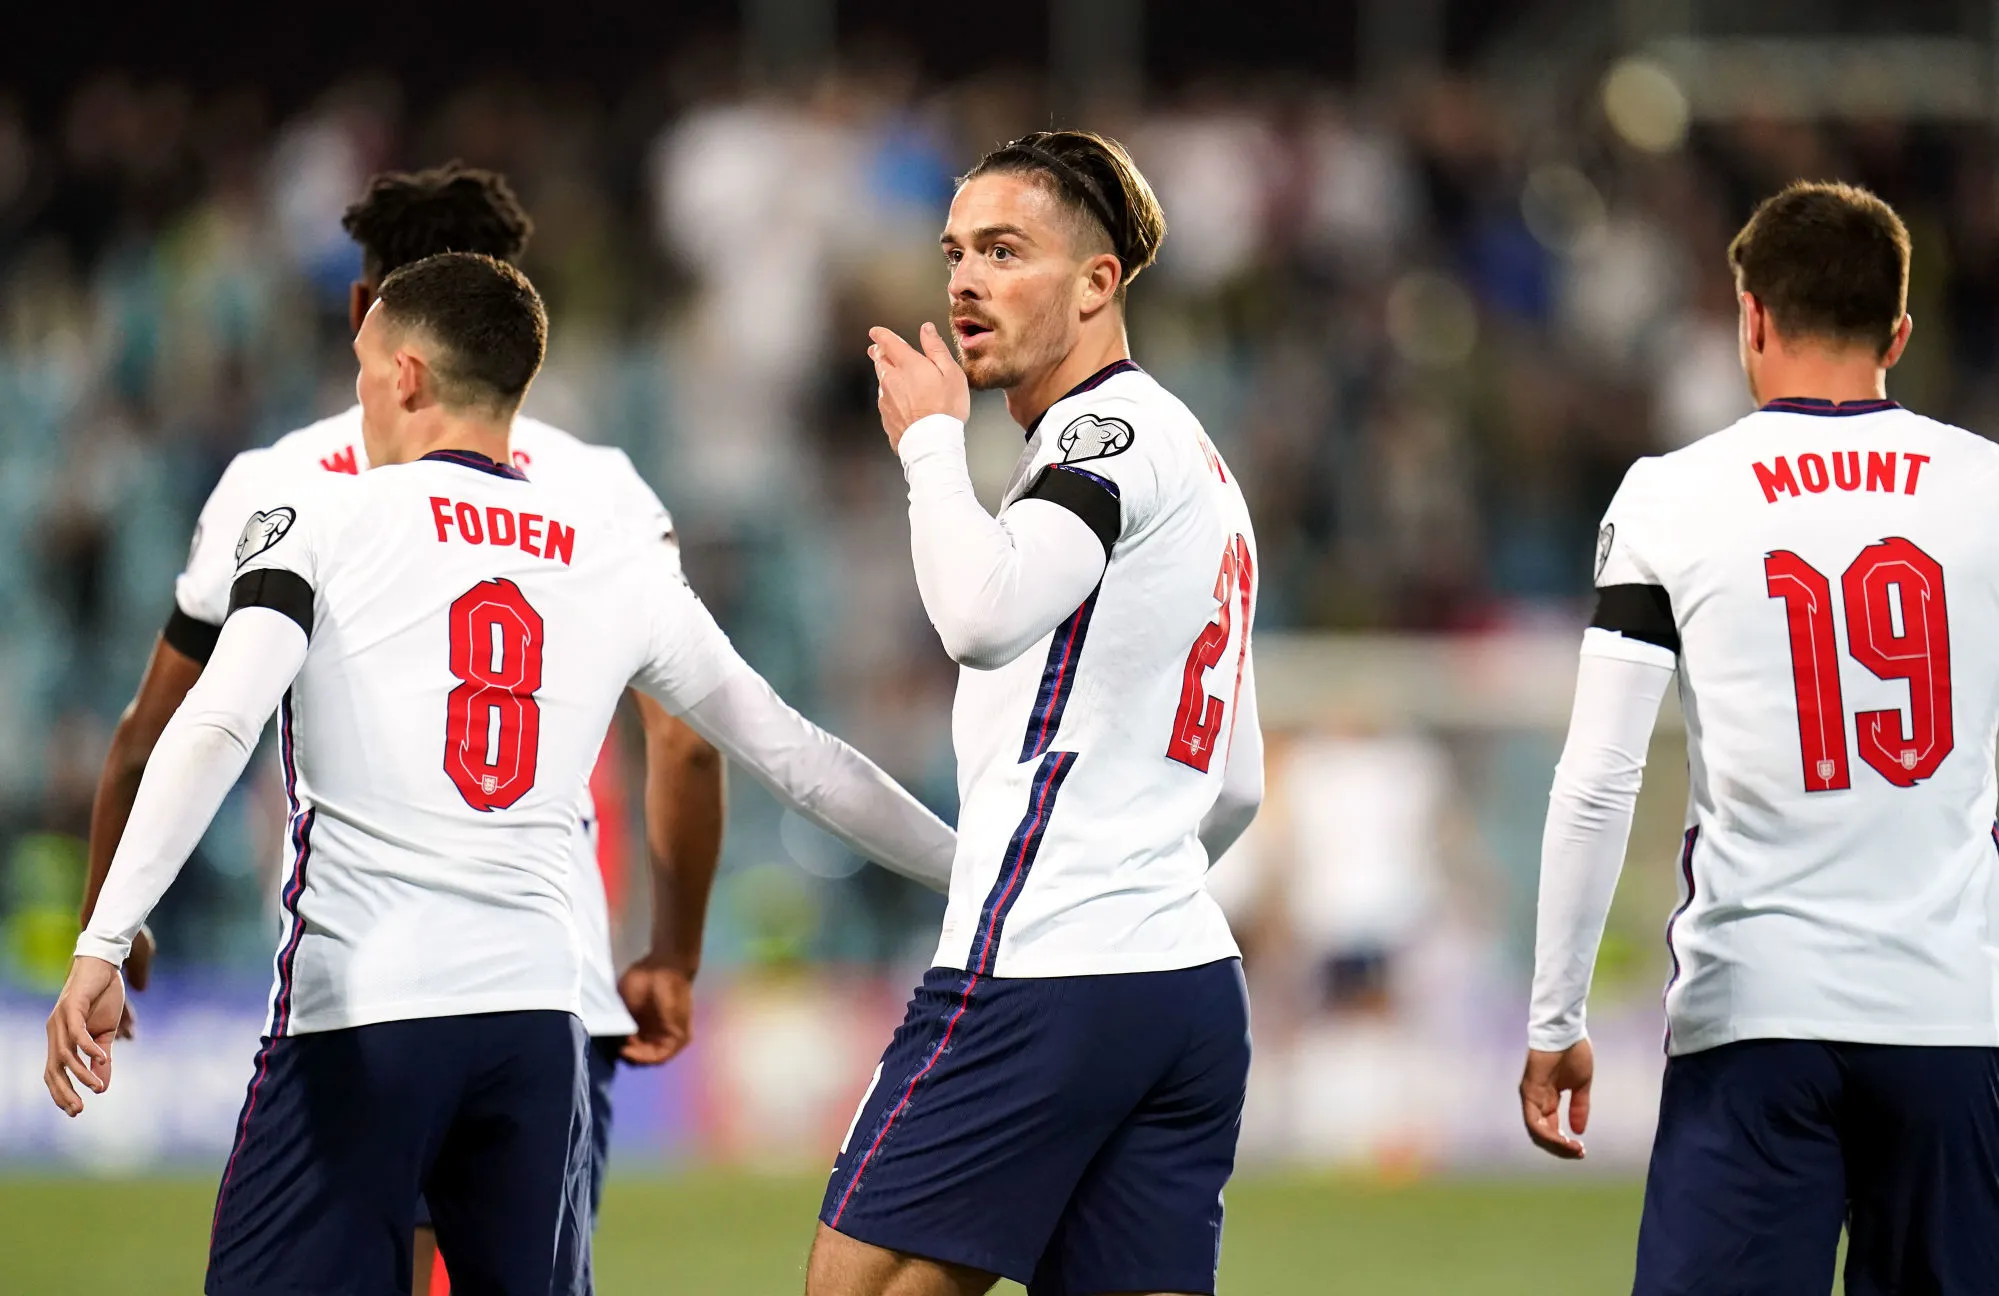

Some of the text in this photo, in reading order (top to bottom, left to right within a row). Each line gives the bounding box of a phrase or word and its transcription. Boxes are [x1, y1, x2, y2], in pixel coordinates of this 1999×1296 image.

[429, 496, 576, 567] FODEN
[1752, 451, 1931, 504] MOUNT
[443, 577, 544, 813] 8
[1764, 536, 1955, 792] 19
